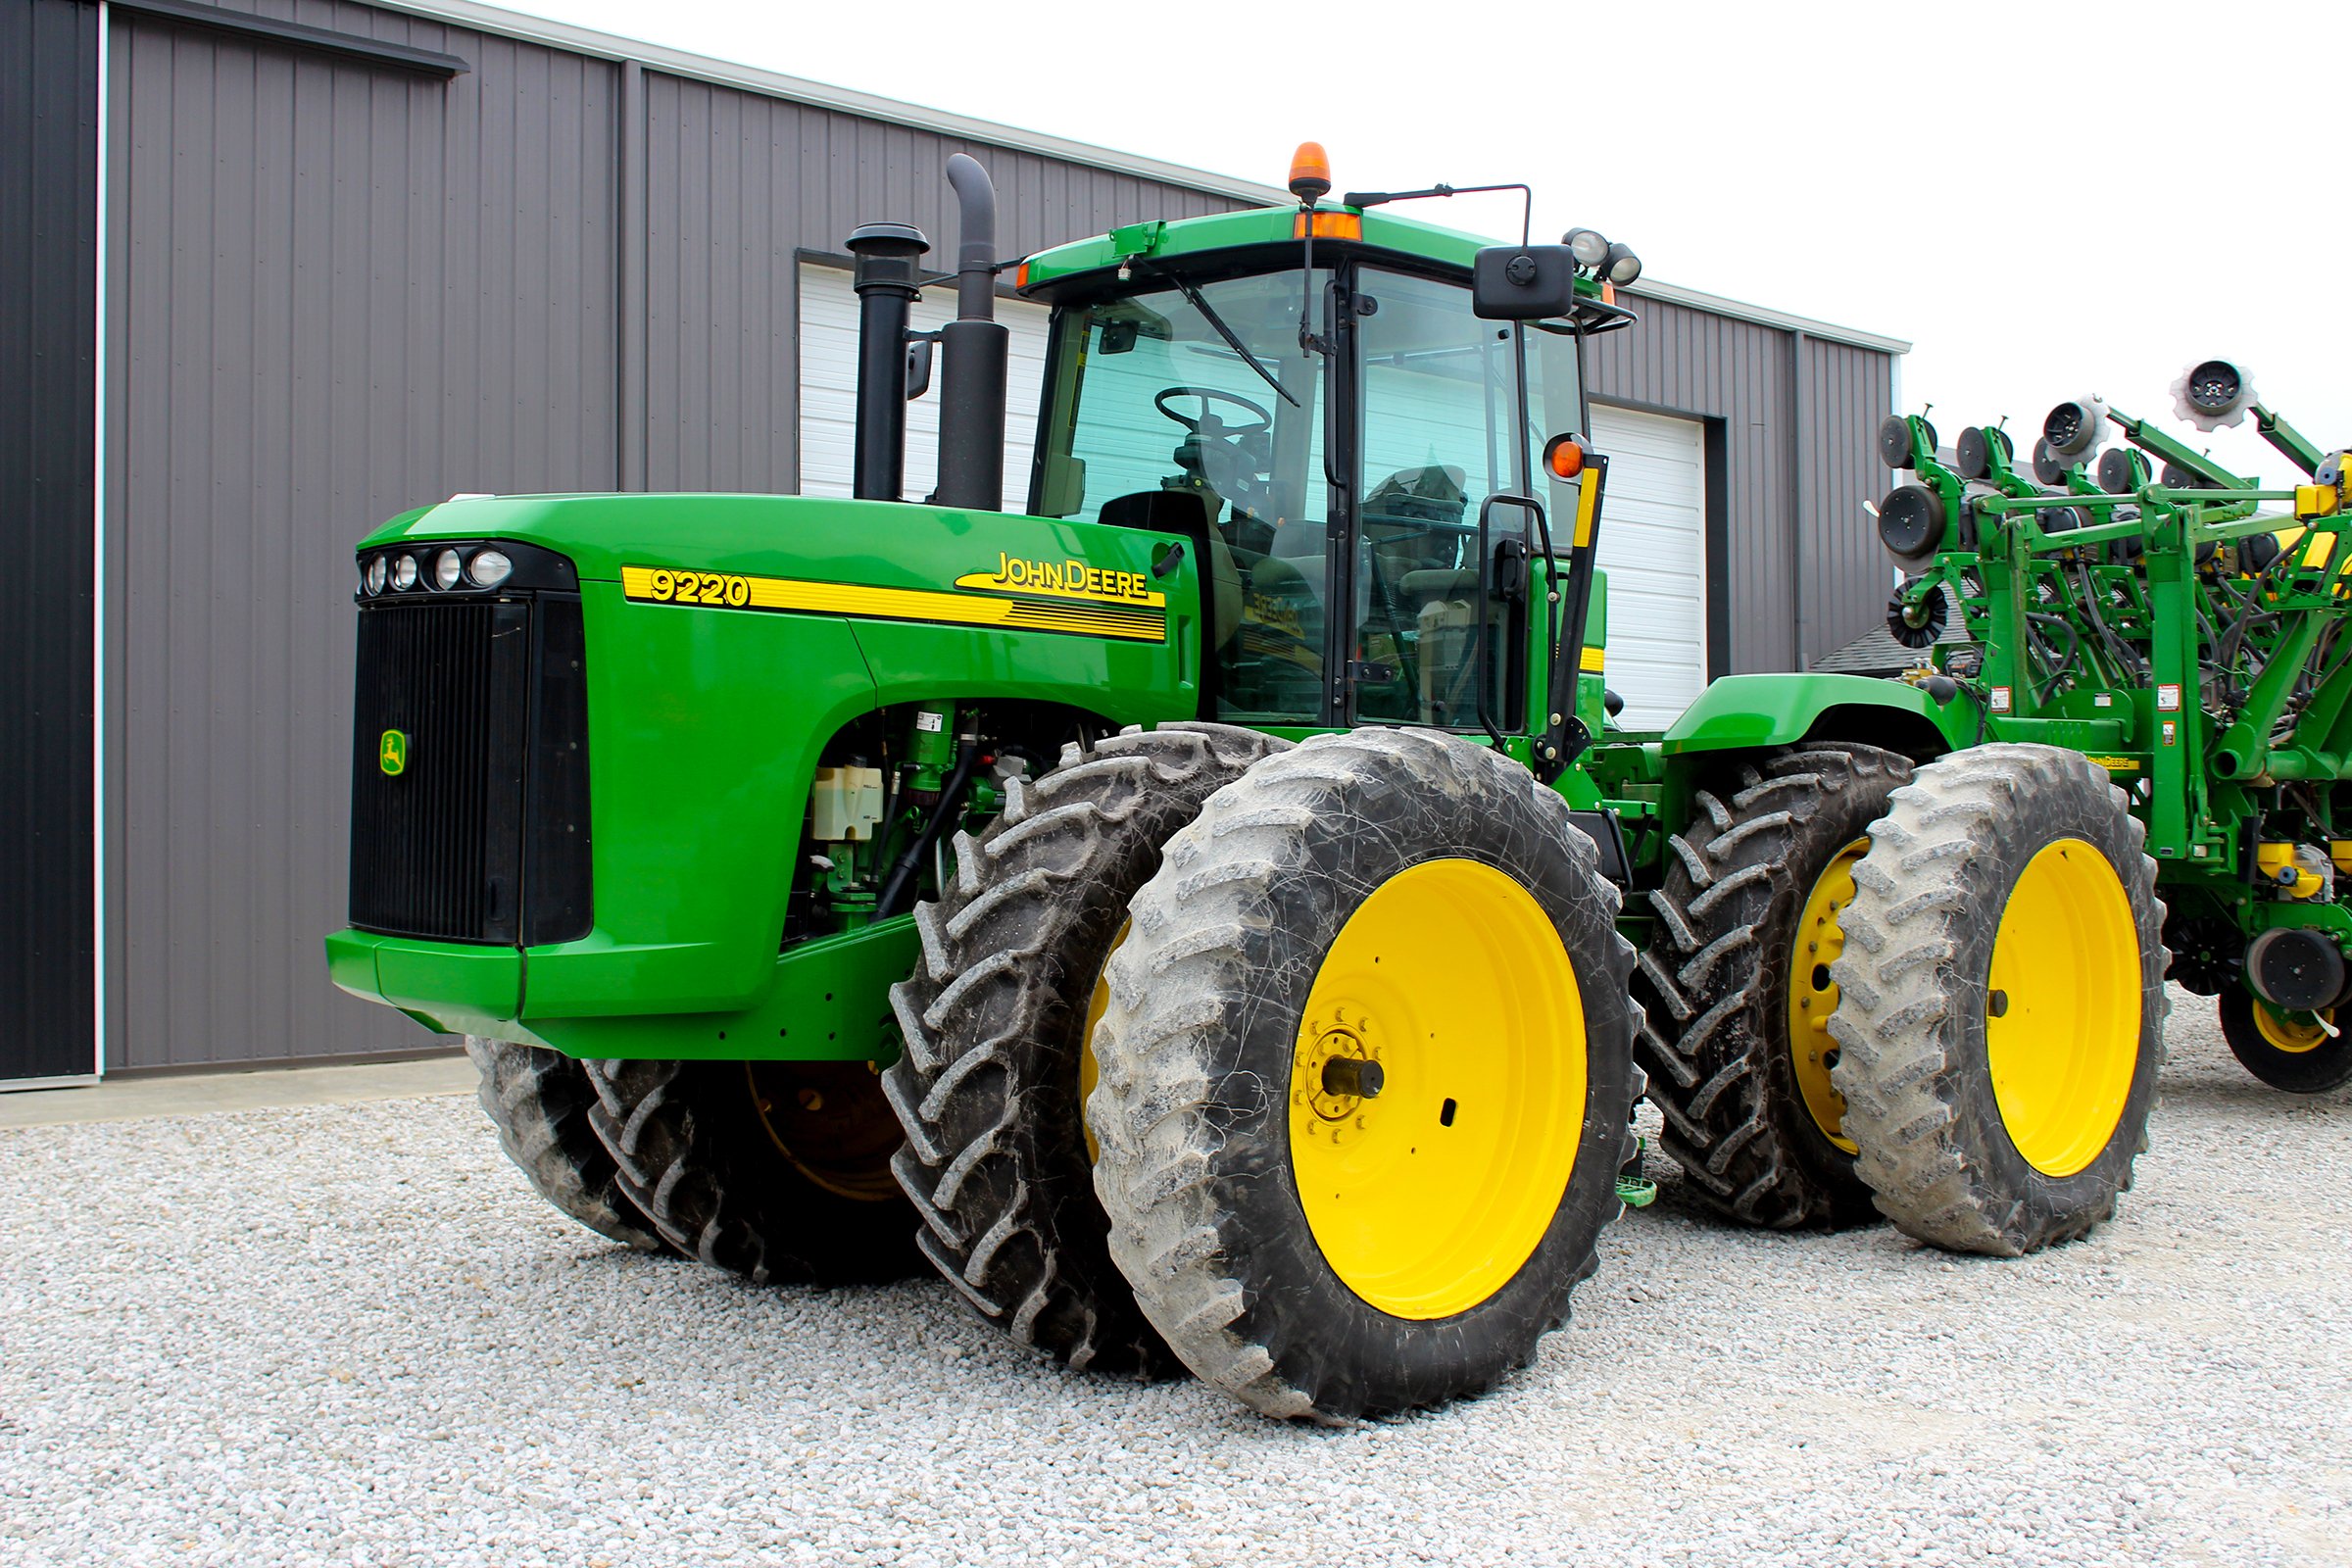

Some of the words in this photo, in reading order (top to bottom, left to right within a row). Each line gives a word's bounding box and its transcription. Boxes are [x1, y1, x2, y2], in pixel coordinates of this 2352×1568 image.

[651, 568, 751, 607] 9220
[992, 551, 1065, 588] JOHN
[1066, 559, 1149, 599] DEERE
[2105, 756, 2130, 767] DEERE
